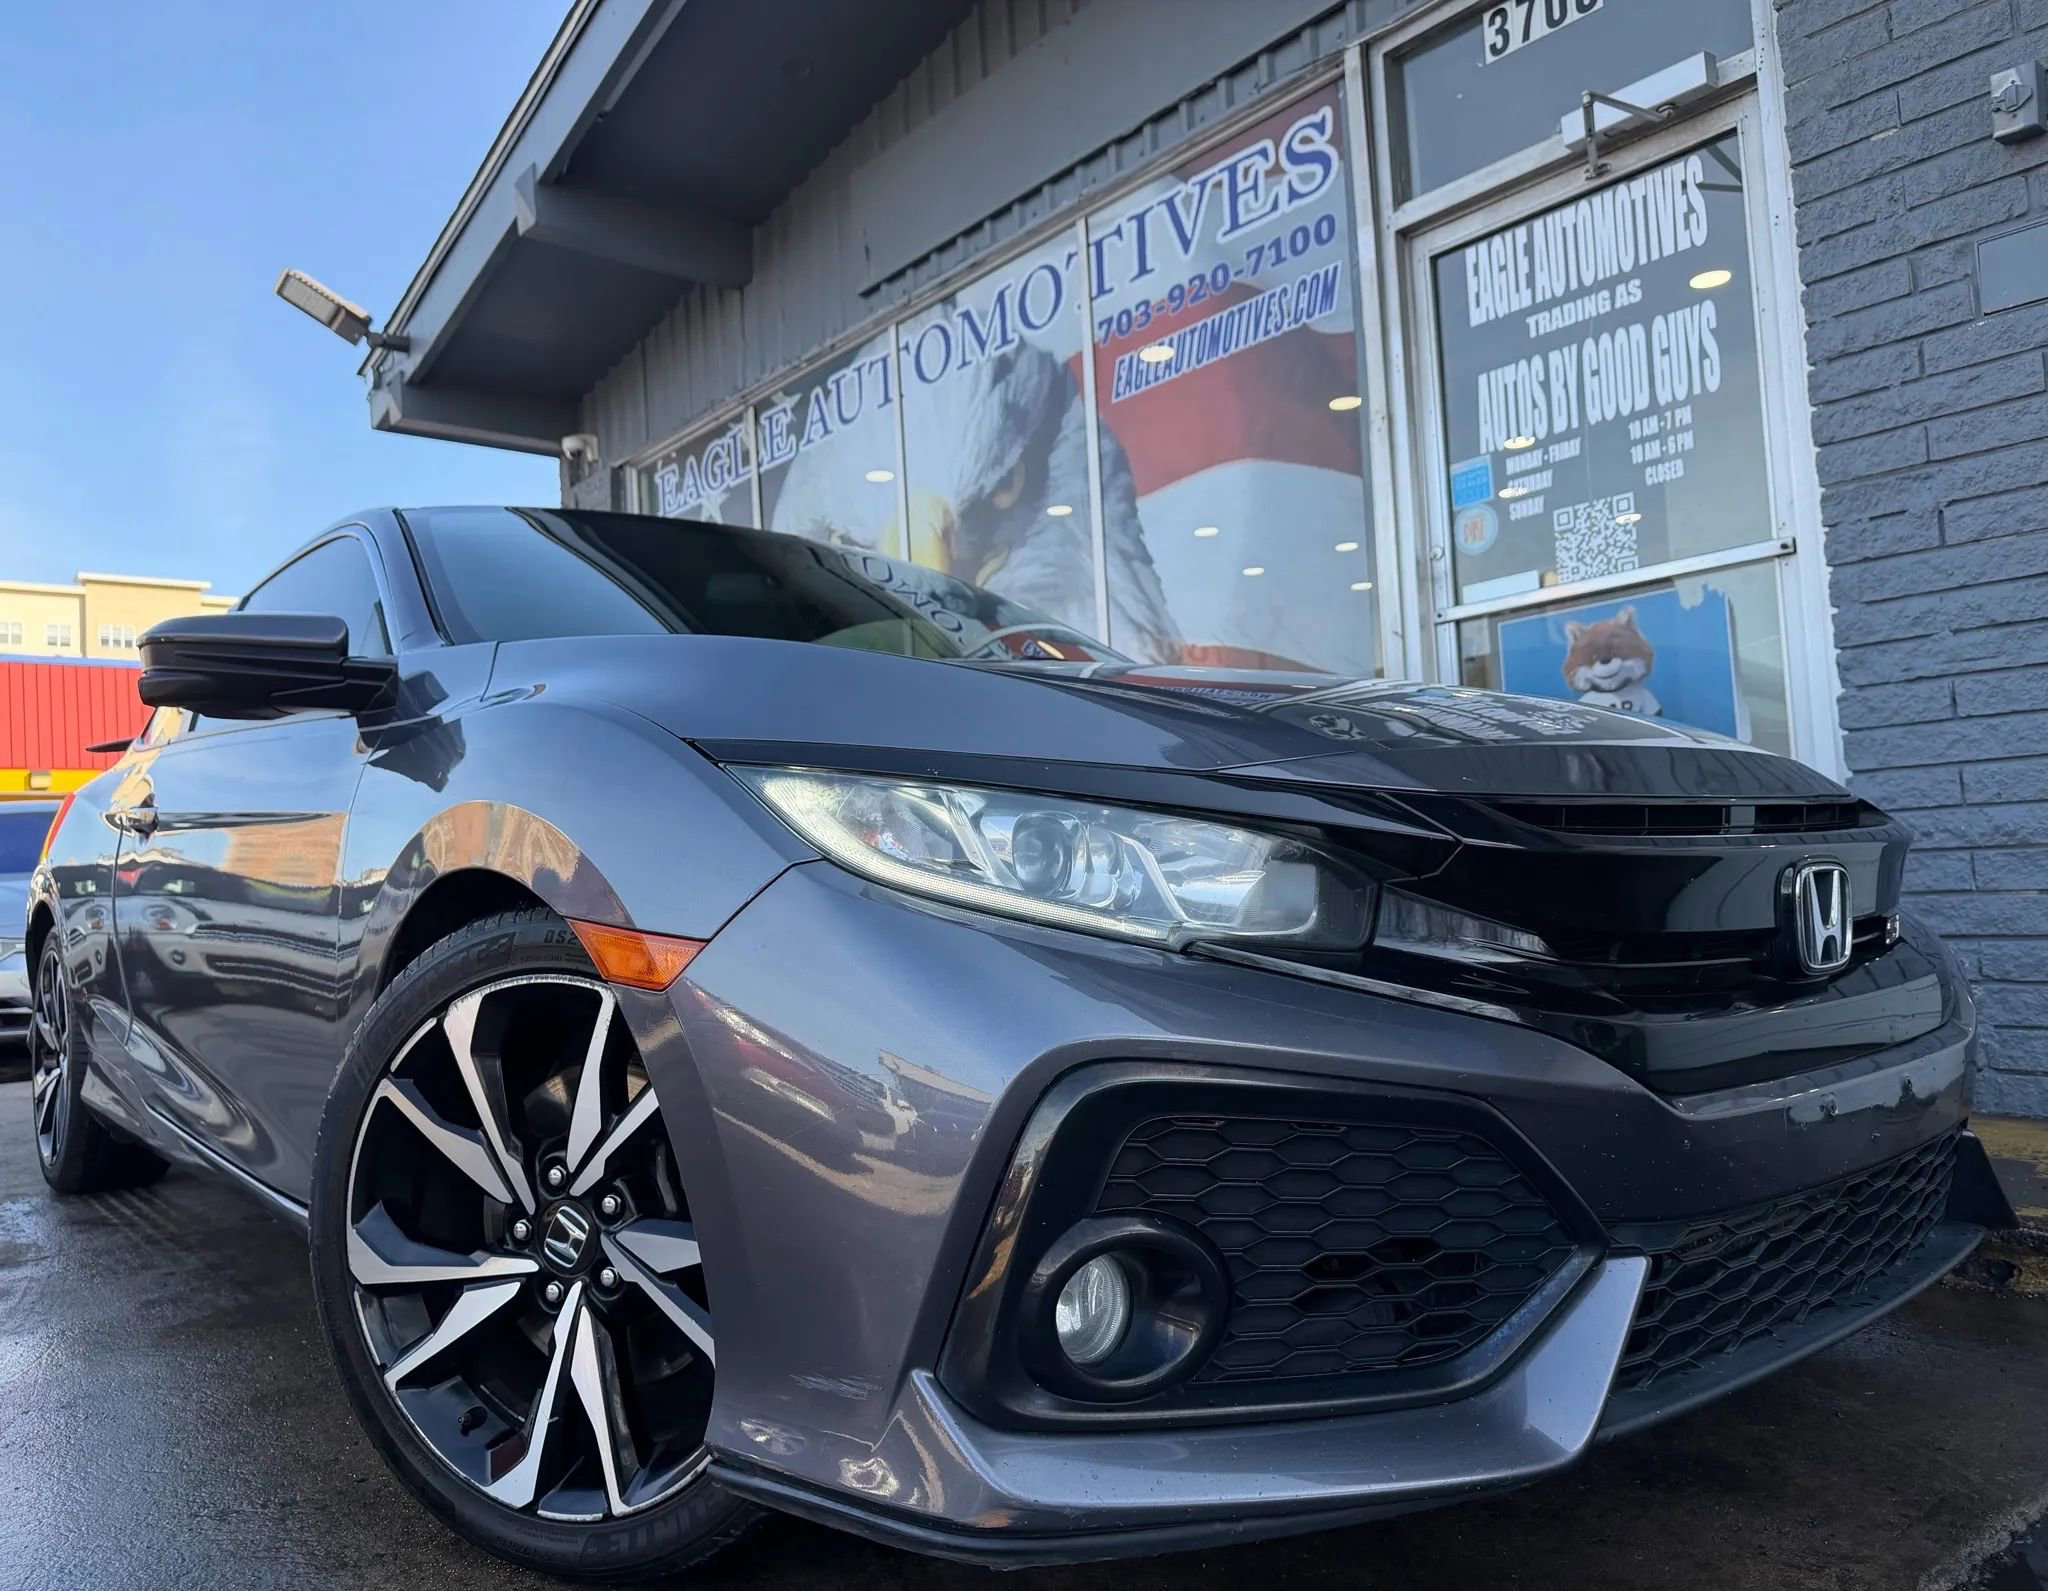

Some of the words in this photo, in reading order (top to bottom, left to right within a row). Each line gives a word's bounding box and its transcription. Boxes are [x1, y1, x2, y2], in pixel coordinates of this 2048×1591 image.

[1488, 0, 1598, 57] 370
[1098, 214, 1336, 345] 703-920-7100
[1465, 230, 1532, 328] EAGLE
[1533, 155, 1709, 304] AUTOMOTIVES
[657, 404, 796, 517] EAGLE
[802, 107, 1339, 447] AUTOMOTIVES
[1113, 262, 1340, 401] EAGLEAUTOMOTIVES.COM
[1526, 289, 1612, 338] TRADING
[1615, 279, 1642, 309] AS
[1477, 354, 1548, 454] AUTOS
[1548, 343, 1579, 435] BY
[1582, 323, 1650, 425] GOOD
[1651, 299, 1721, 406] GUYS
[1674, 404, 1693, 427] PM
[1645, 458, 1685, 487] CLOSED
[1676, 429, 1695, 453] PM
